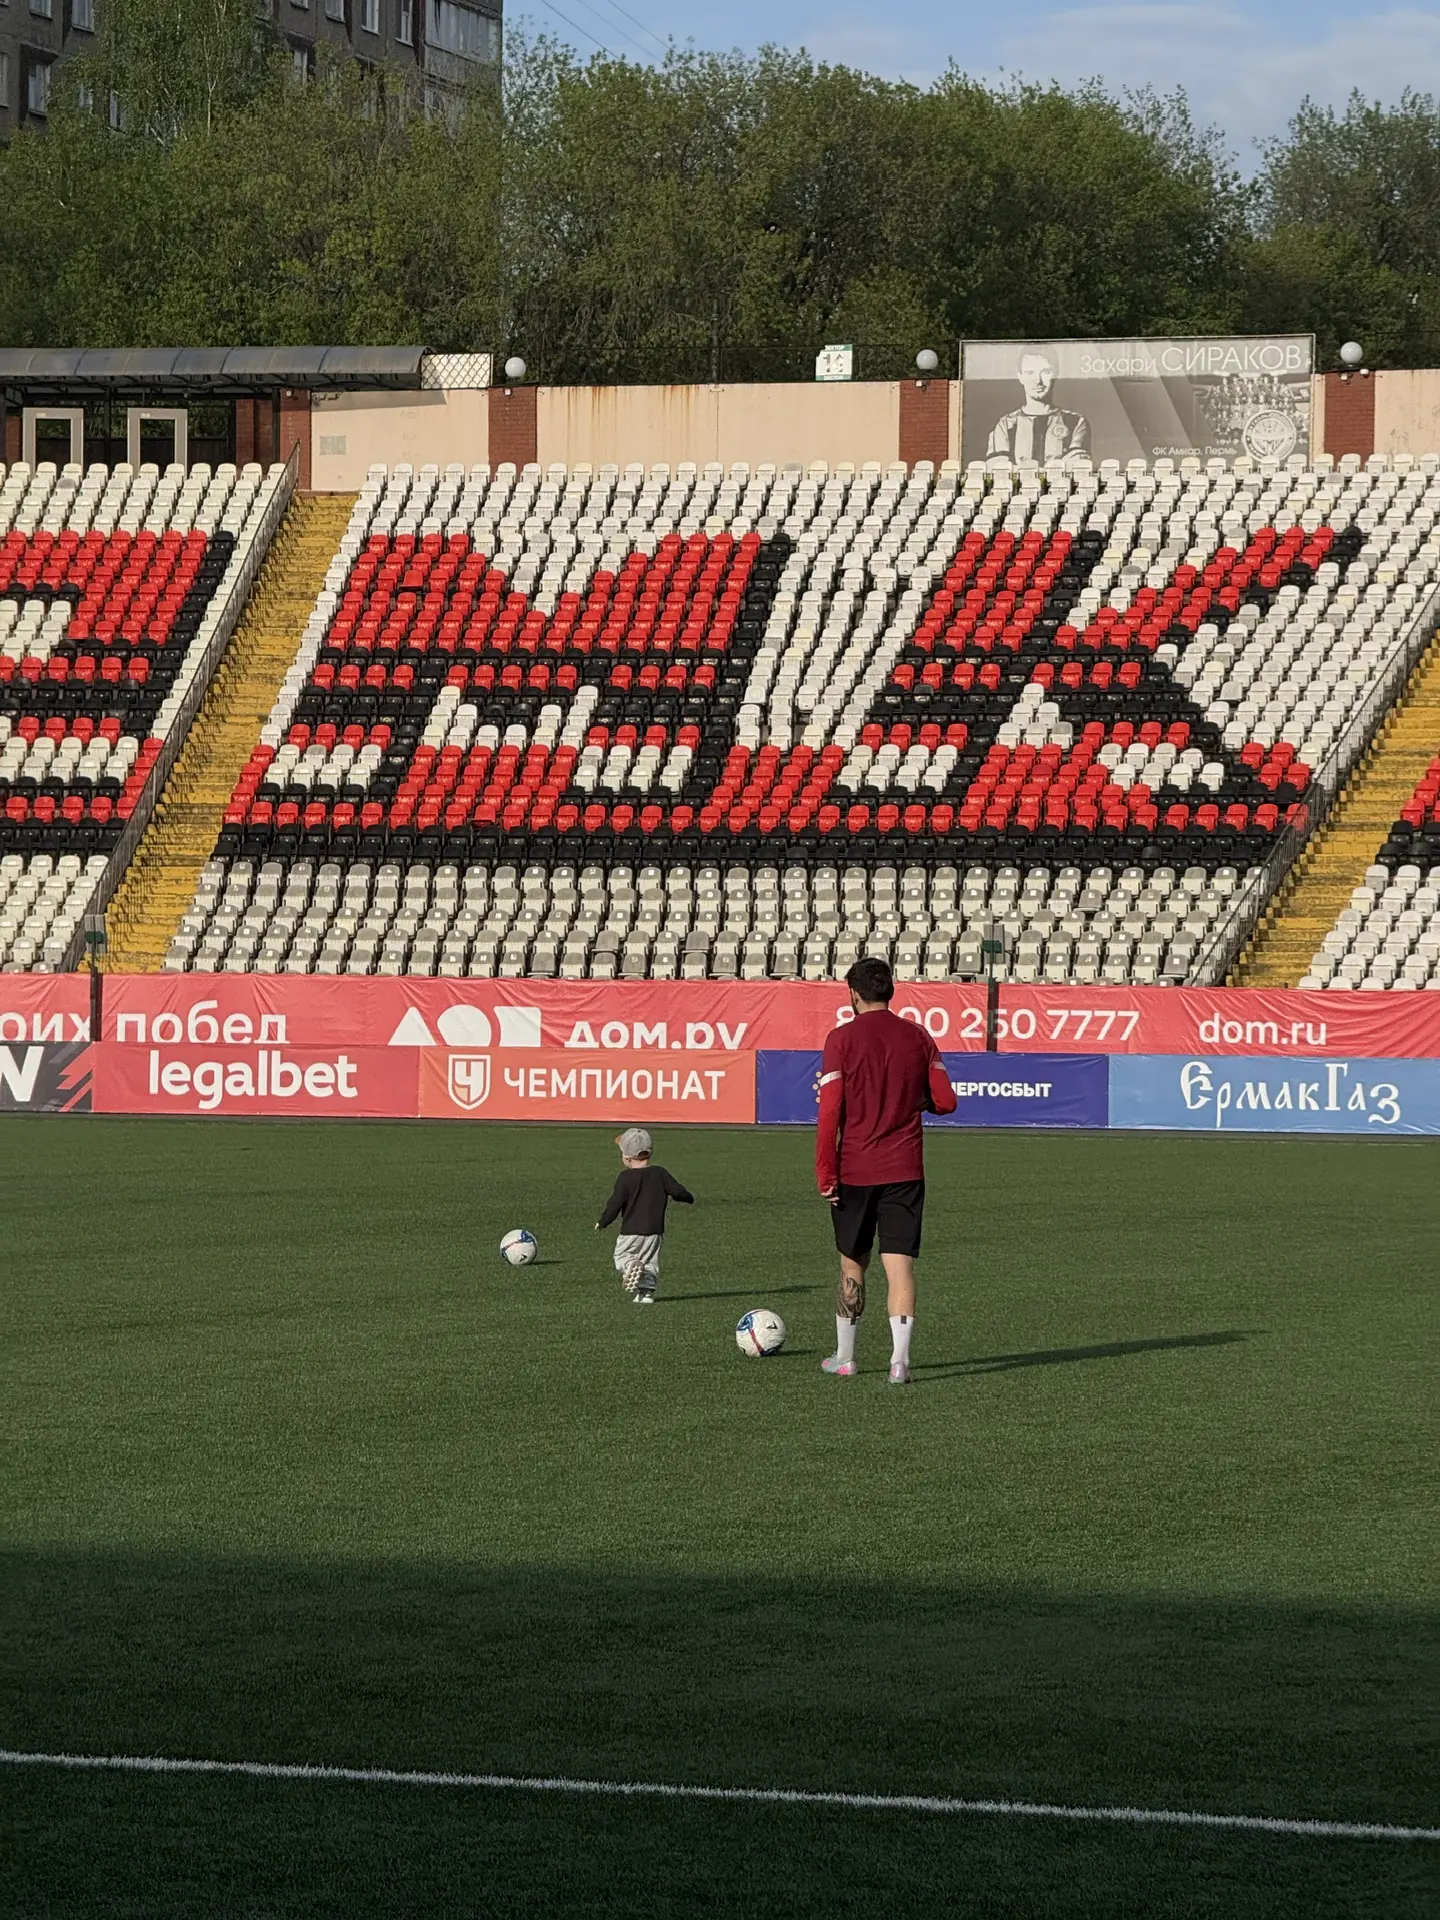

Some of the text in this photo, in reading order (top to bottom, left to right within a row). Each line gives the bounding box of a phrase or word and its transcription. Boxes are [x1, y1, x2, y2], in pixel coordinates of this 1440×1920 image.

[1080, 345, 1302, 376] Захари СИРАКОВ
[1151, 446, 1167, 456] ФК
[1204, 445, 1238, 457] Пермь
[115, 999, 291, 1044] побед
[960, 1006, 1037, 1040] 250
[1046, 1008, 1140, 1041] 7777
[1199, 1012, 1327, 1045] dom.ru
[149, 1049, 358, 1110] legalbet
[503, 1067, 726, 1100] ЧЕМПИОНАТ
[952, 1082, 1052, 1098] ЕРГОСБЫТ
